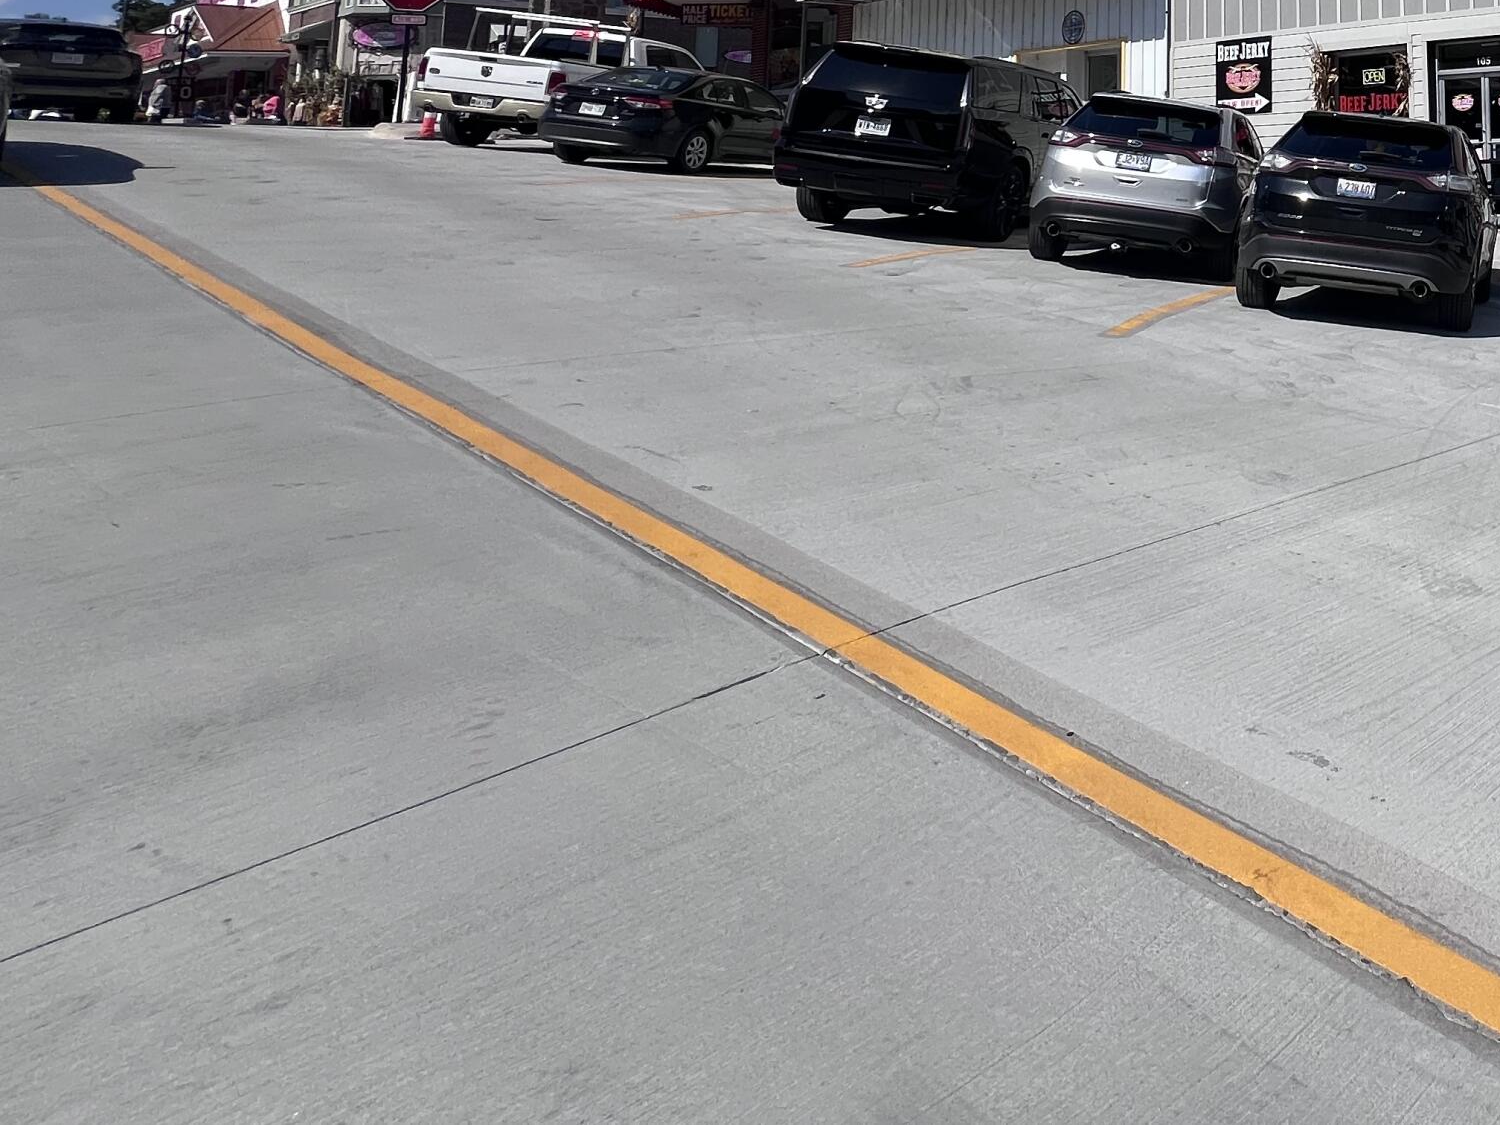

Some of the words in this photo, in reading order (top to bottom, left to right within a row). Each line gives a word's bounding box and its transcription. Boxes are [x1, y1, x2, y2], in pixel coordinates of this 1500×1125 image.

[682, 5, 708, 14] HALF
[709, 4, 753, 17] TICKET
[682, 15, 707, 24] PRICE
[1217, 45, 1240, 62] BEEF
[1240, 42, 1270, 60] JERKY
[1364, 71, 1385, 83] OPEN
